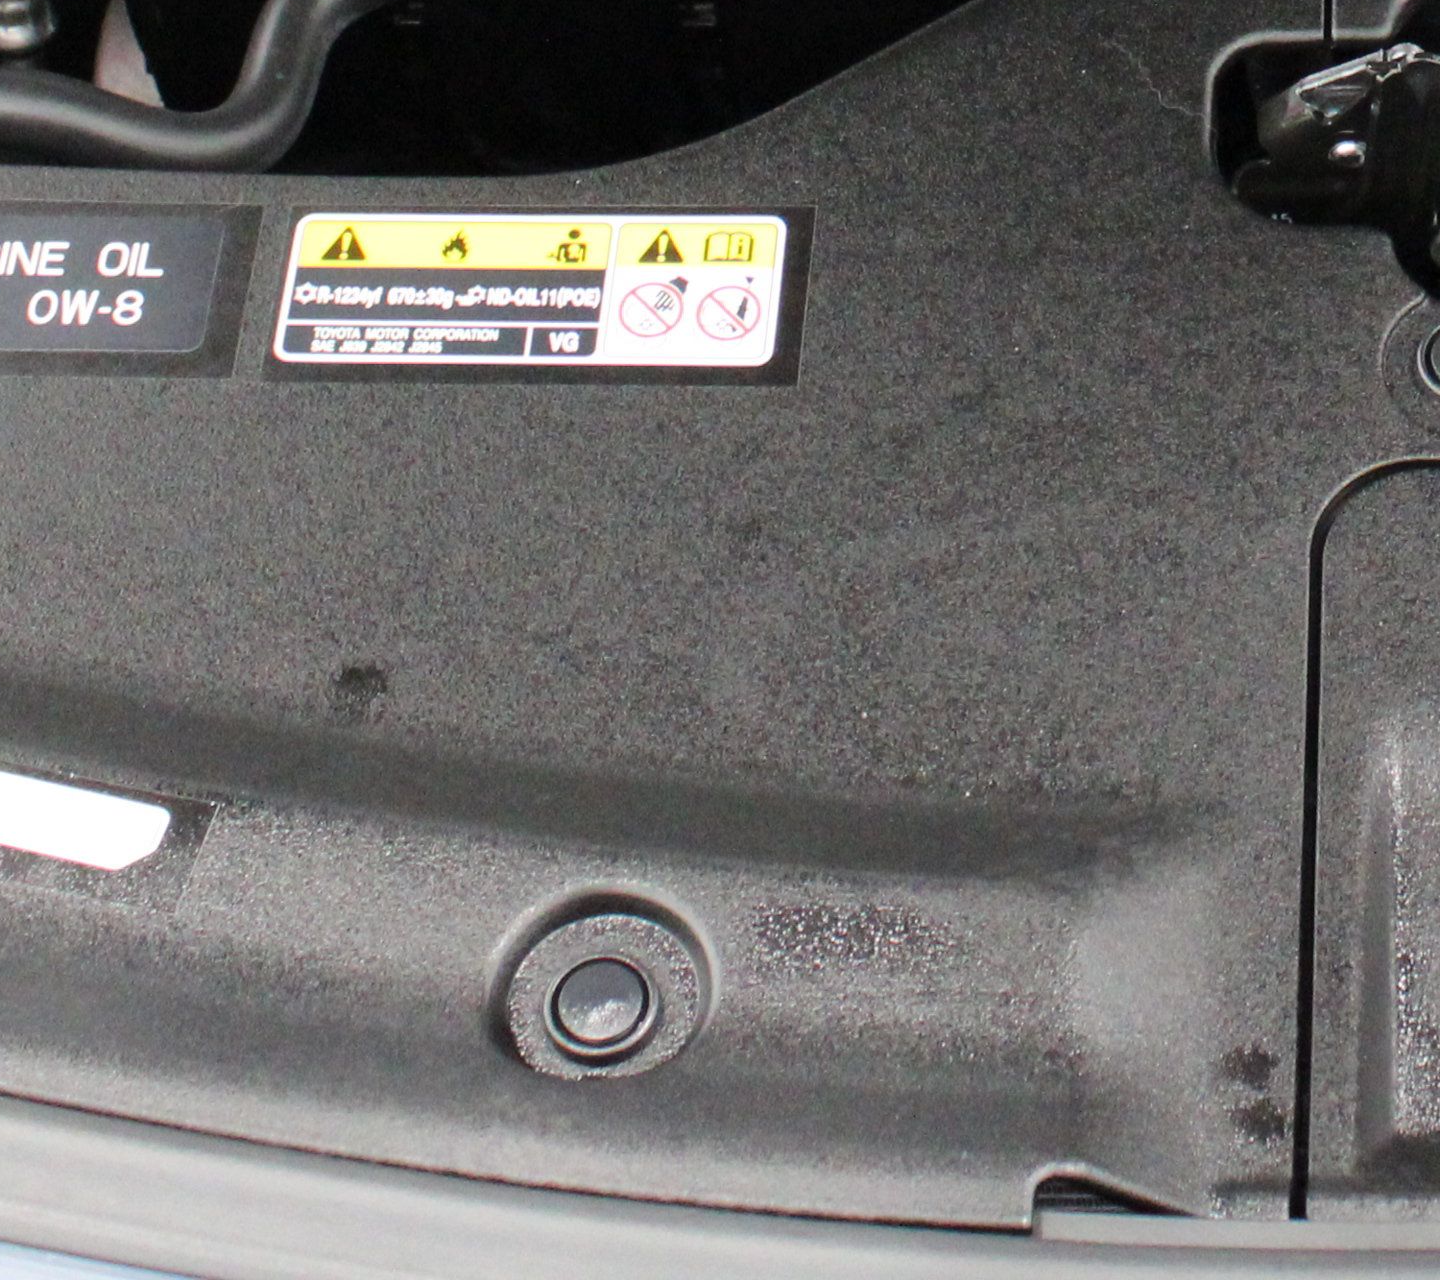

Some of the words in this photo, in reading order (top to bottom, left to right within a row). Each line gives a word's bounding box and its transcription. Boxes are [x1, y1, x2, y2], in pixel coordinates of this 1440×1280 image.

[96, 240, 164, 278] OIL
[26, 289, 146, 326] 0W-8
[313, 326, 361, 340] TOYOTA
[364, 327, 409, 341] MOTOR
[412, 328, 500, 342] CORPORATION
[548, 331, 580, 353] VG
[310, 339, 336, 352] SAE
